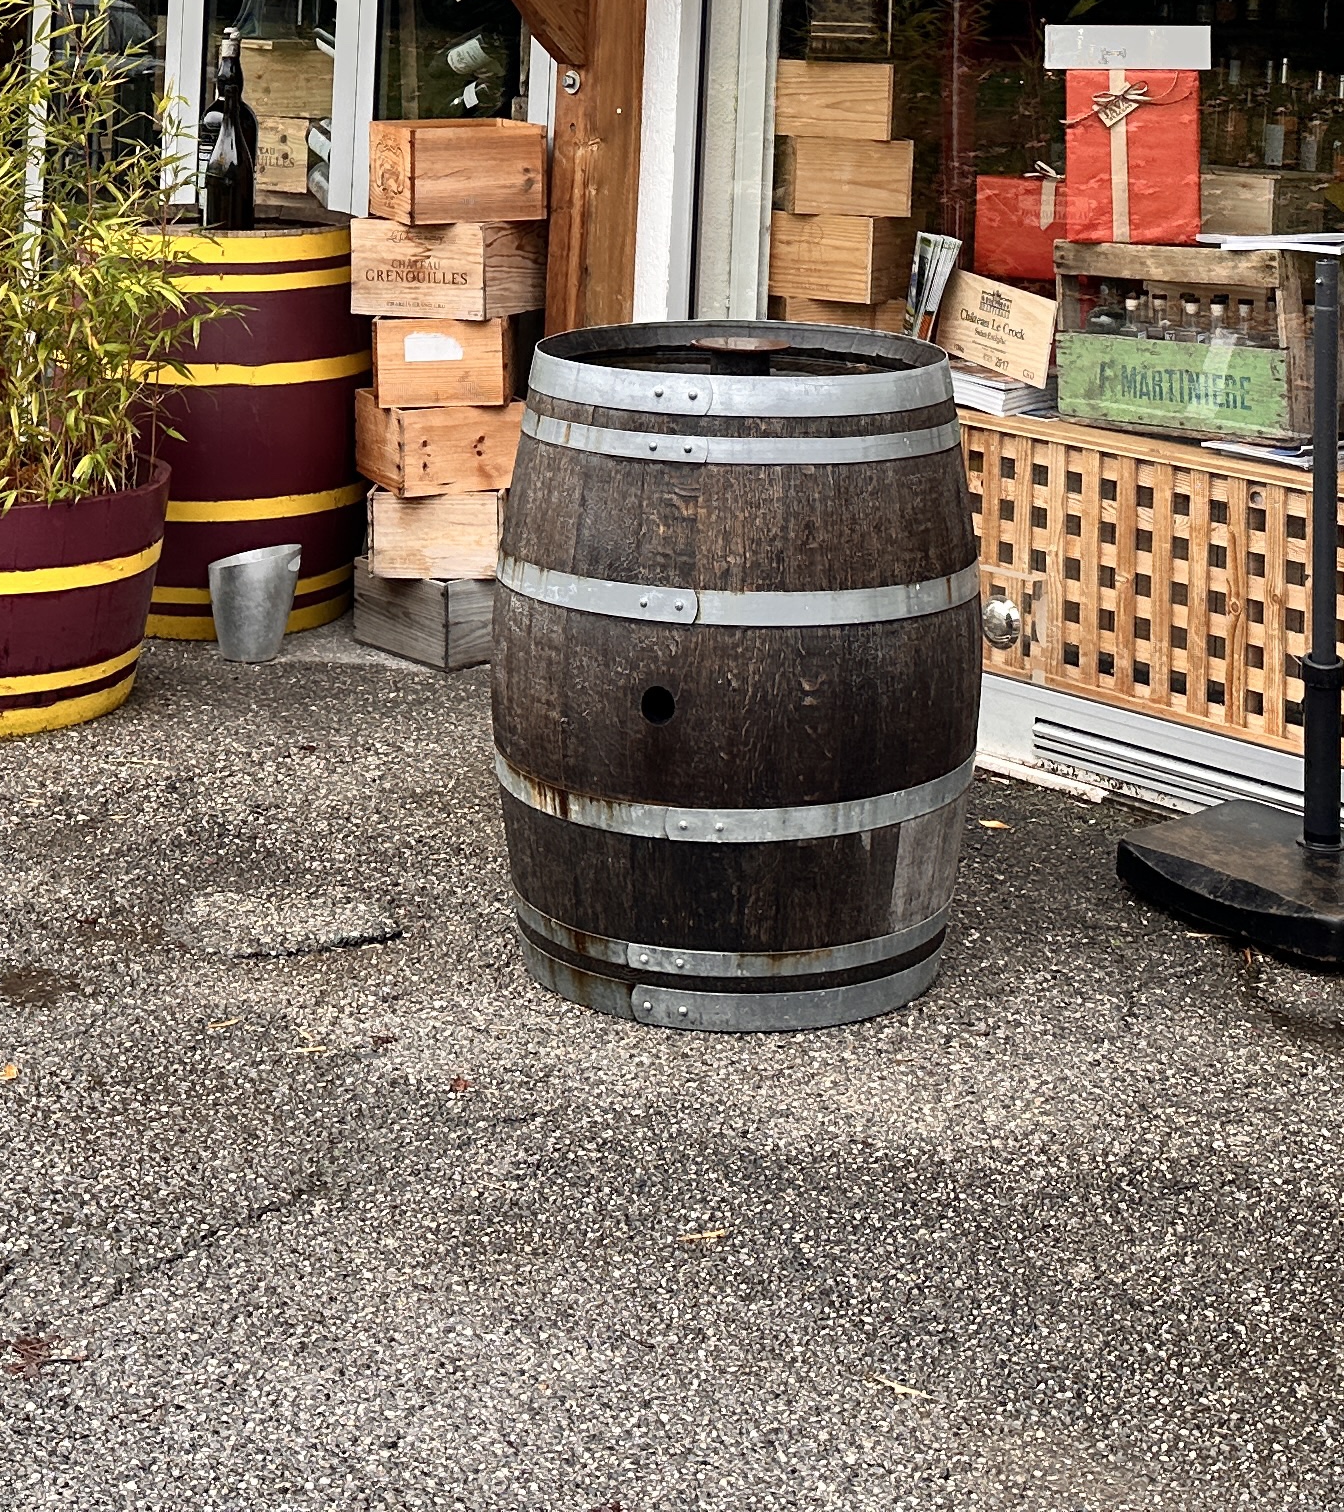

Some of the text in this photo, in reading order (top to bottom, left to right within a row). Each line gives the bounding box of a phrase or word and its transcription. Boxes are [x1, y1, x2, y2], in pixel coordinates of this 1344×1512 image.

[365, 269, 468, 286] GRENOUILLES
[960, 308, 1025, 341] Château Le Crock
[1121, 364, 1252, 411] MARTINIERE
